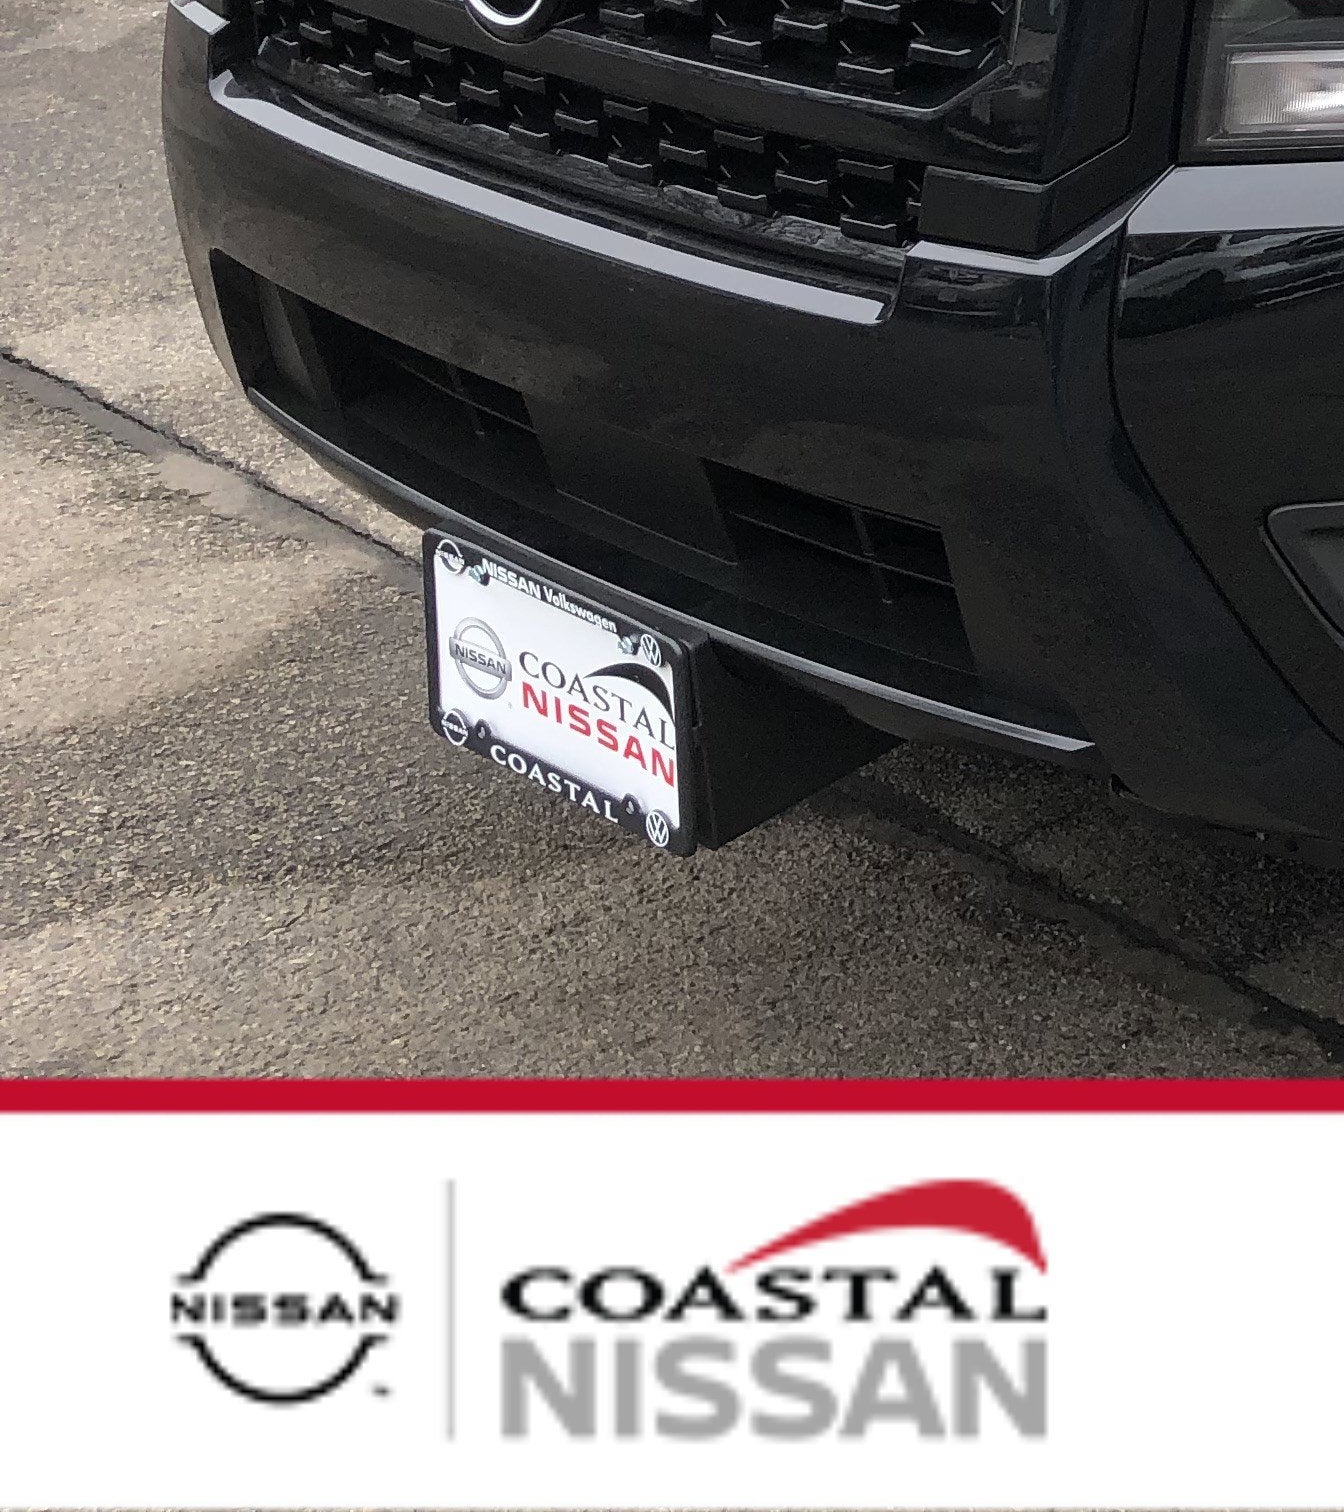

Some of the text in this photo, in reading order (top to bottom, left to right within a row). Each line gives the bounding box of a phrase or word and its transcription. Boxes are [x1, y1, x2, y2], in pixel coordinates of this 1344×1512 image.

[481, 557, 618, 633] NISSAN Volkswagen
[454, 643, 507, 675] NISSAN
[518, 651, 675, 751] COASTAL
[521, 680, 675, 789] NISSAN
[490, 744, 619, 824] COASTAL
